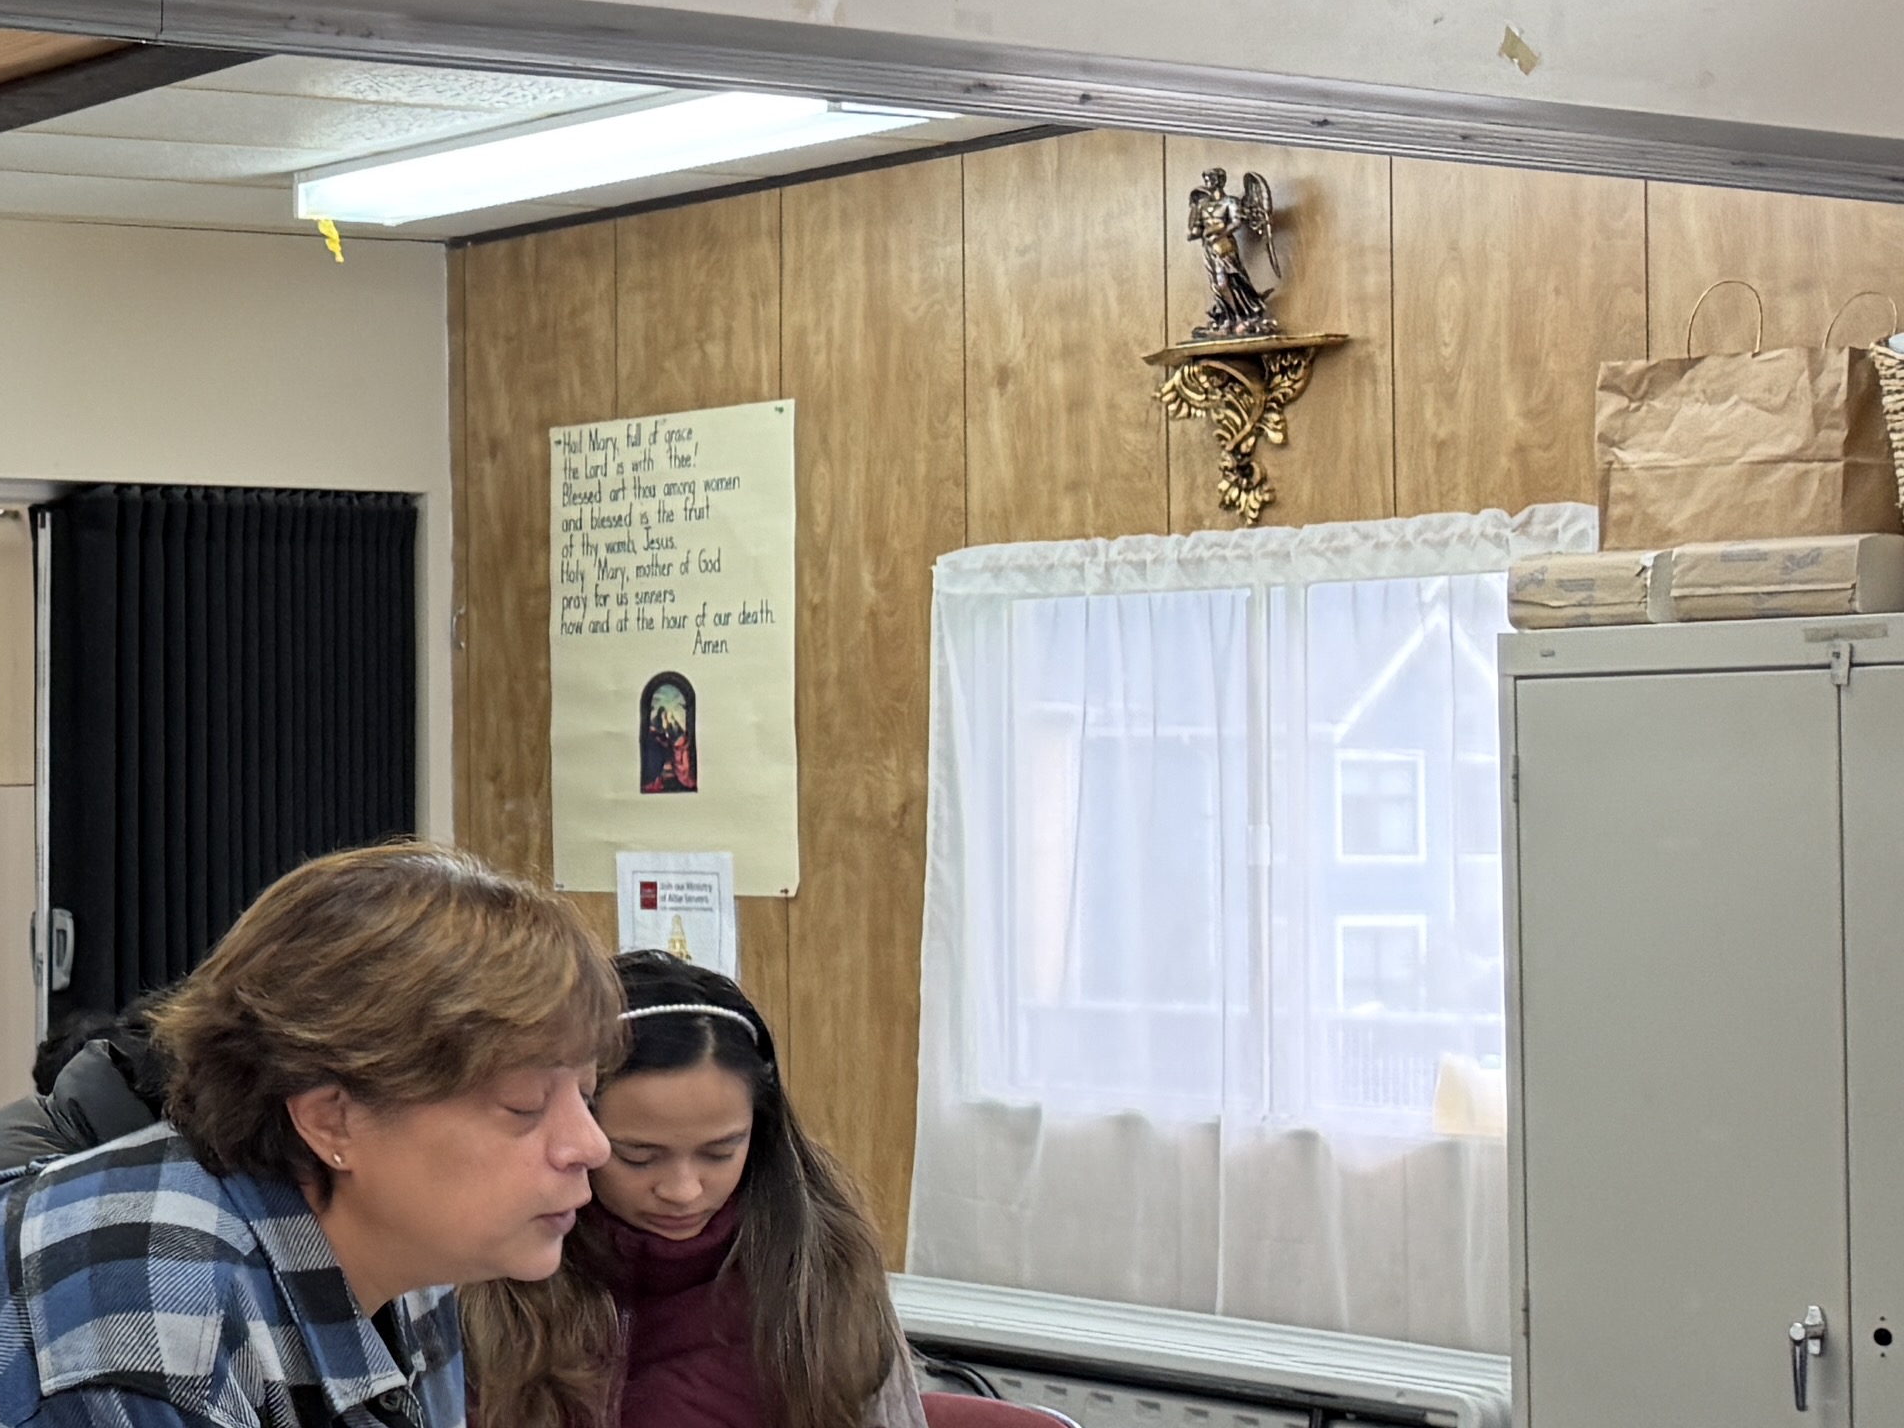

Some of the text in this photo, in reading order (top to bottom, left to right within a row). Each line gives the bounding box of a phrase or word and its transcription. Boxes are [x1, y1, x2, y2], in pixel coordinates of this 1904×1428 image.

[562, 420, 694, 463] Hail Mary, full of grace
[564, 456, 579, 481] the
[585, 453, 608, 479] Lord
[617, 461, 625, 476] is
[632, 448, 655, 473] with
[562, 475, 741, 508] Blessed art thou among women
[562, 496, 711, 532] and blessed is the fruit
[562, 534, 574, 559] of
[581, 532, 599, 565] thy
[561, 547, 721, 592] Holy Mary, mother of God
[562, 583, 676, 619] pray for us sinners
[588, 609, 610, 634] and
[616, 608, 628, 632] at
[636, 607, 655, 631] the
[661, 605, 689, 630] hour
[695, 602, 708, 628] of
[713, 612, 732, 628] our
[692, 629, 729, 655] Amen
